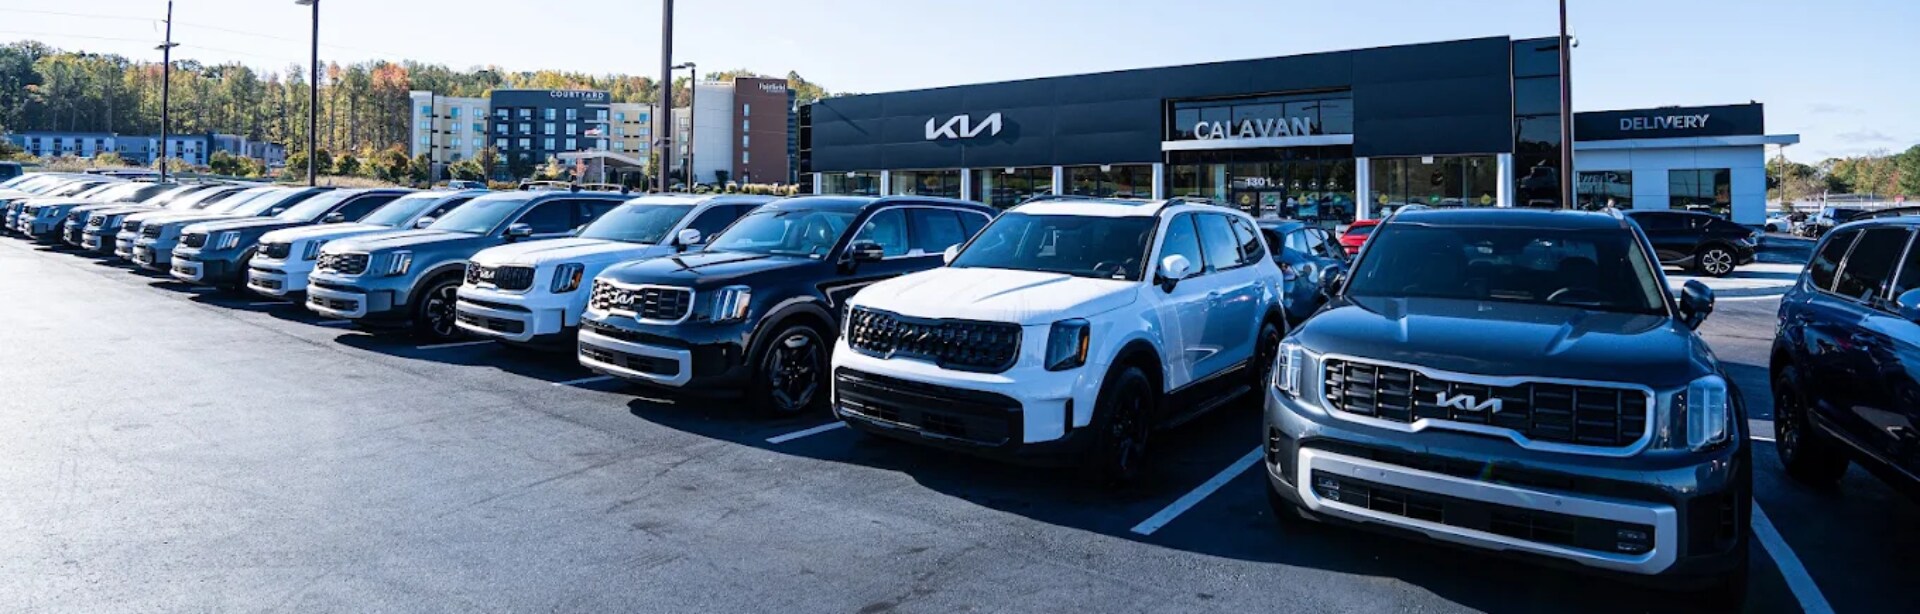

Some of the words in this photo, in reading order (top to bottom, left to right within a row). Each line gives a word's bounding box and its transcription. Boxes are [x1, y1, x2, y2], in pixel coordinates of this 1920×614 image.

[550, 91, 604, 99] COURTYARD
[925, 112, 1002, 140] KIA
[1193, 117, 1310, 140] CALAVAN
[1620, 113, 1710, 131] DELIVERY
[1245, 177, 1272, 187] 1301
[1436, 391, 1503, 413] KIA
